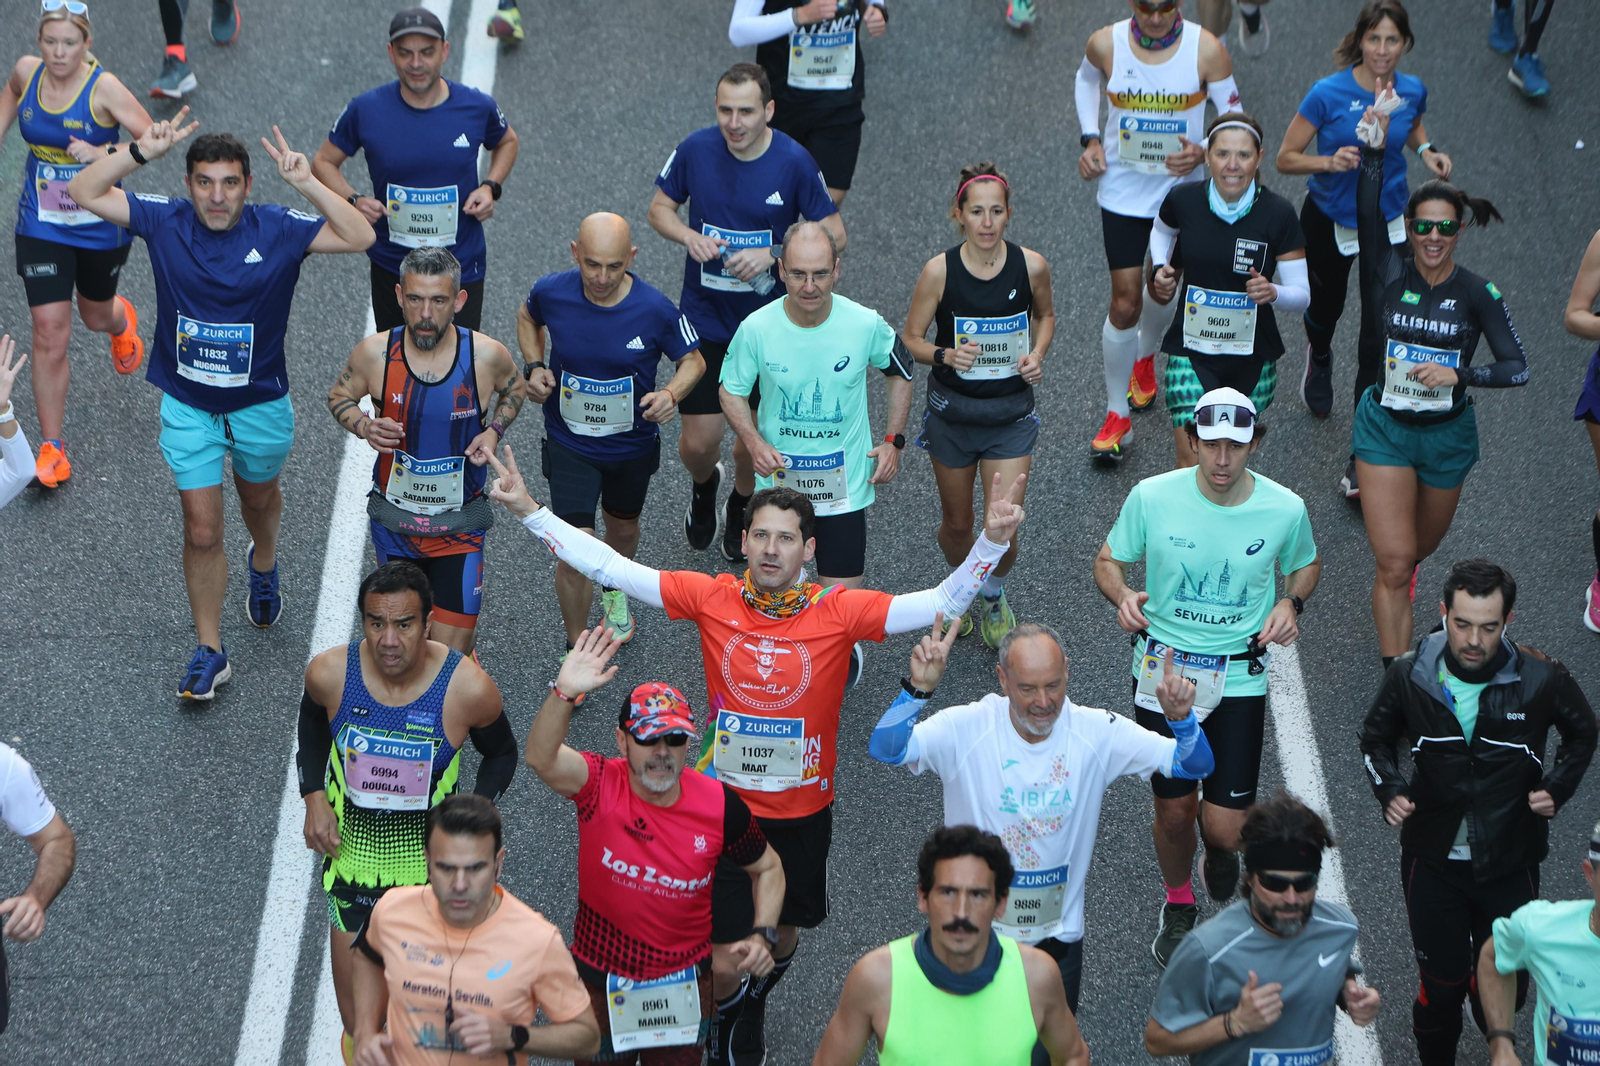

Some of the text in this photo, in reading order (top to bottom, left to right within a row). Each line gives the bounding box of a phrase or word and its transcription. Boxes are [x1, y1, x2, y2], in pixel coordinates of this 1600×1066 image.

[815, 35, 847, 46] ZURICH
[813, 55, 834, 64] 9547
[807, 66, 837, 76] GONZALO
[1117, 87, 1190, 107] eMotion
[1132, 105, 1174, 117] running
[1142, 121, 1179, 132] ZURICH
[1141, 140, 1163, 150] 8948
[1139, 152, 1166, 161] PRIETO
[411, 192, 449, 203] ZURICH
[411, 212, 433, 223] 9293
[406, 225, 439, 235] JUANELI
[724, 235, 763, 246] ZURICH
[1209, 295, 1249, 307] ZURICH
[982, 320, 1020, 332] ZURICH
[1207, 316, 1230, 327] 9603
[1392, 313, 1458, 336] ELISIANE
[203, 326, 243, 340] ZURICH
[1199, 330, 1237, 340] ADELAIDE
[979, 342, 1008, 353] 10818
[198, 347, 228, 361] 11832
[1410, 350, 1449, 364] ZURICH
[193, 359, 231, 374] NUGONAL
[976, 356, 1011, 366] 1599362
[584, 382, 623, 394] ZURICH
[1393, 384, 1440, 398] ELIS TONOLI
[583, 402, 607, 413] 9784
[585, 415, 606, 424] PACO
[779, 427, 841, 439] SEVILLA'24
[415, 461, 455, 474] ZURICH
[797, 457, 838, 469] ZURICH
[412, 482, 438, 493] 9716
[796, 478, 825, 489] 11076
[402, 491, 447, 504] SATANIX05
[805, 492, 834, 502] INATOR
[1174, 607, 1243, 625] SEVILLA'24
[1173, 652, 1218, 667] ZURICH
[1506, 712, 1527, 721] GORE
[745, 722, 792, 735] ZURICH
[373, 743, 421, 758] ZURICH
[741, 746, 774, 759] 11037
[371, 765, 400, 779] 6994
[741, 764, 768, 774] MAAT
[361, 781, 406, 794] DOUGLAS
[1021, 788, 1073, 807] IBIZA
[1022, 803, 1075, 816] MARATHON
[601, 847, 640, 879] Los
[611, 874, 637, 890] CLUB
[638, 883, 652, 893] DE
[1017, 871, 1060, 886] ZURICH
[1014, 898, 1042, 910] 9886
[1017, 915, 1037, 925] CIRI
[402, 980, 446, 998] Maratón
[642, 998, 669, 1012] 8961
[638, 1015, 679, 1029] MANUEL
[1283, 1050, 1328, 1066] ZURICH
[1569, 1045, 1600, 1062] 1168
